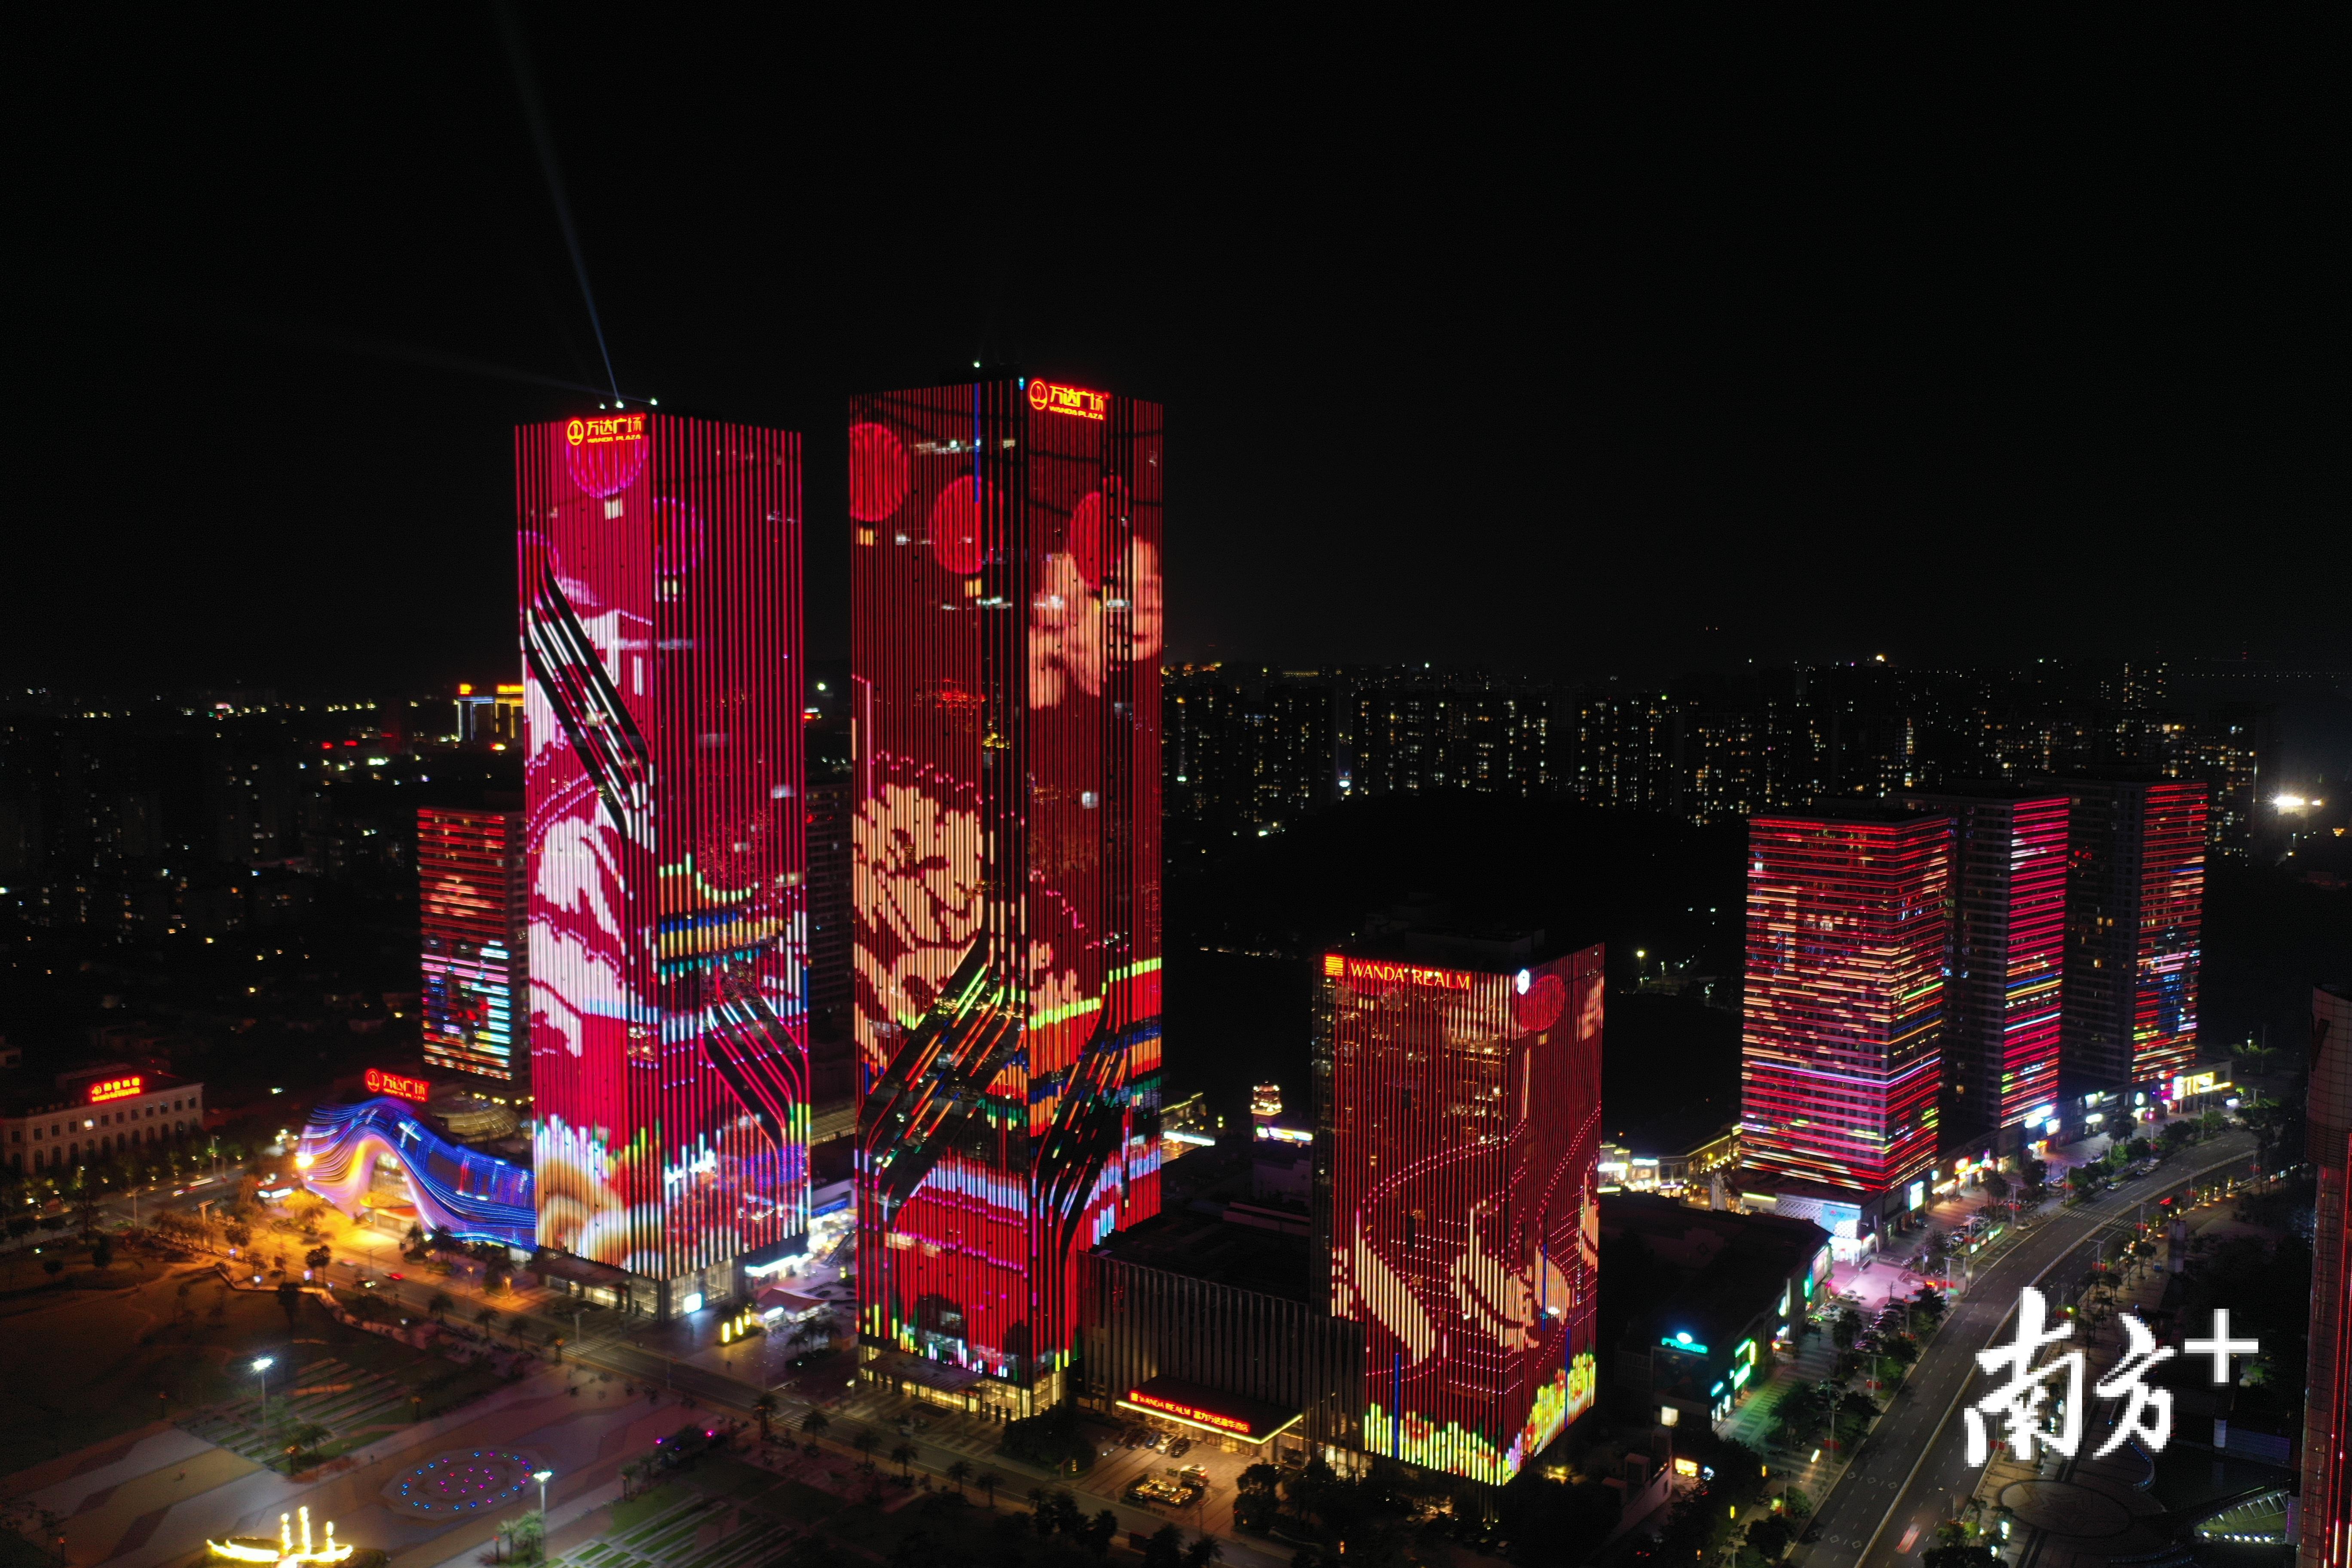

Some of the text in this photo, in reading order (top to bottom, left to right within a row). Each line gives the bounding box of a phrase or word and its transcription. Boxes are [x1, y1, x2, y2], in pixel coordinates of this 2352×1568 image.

[1049, 386, 1104, 412] 万达广场
[1049, 406, 1103, 420] WANDA PLAZA
[586, 416, 642, 436] 万达广场
[1351, 962, 1470, 990] WANDA REALM
[383, 1075, 426, 1095] 万达广场
[1165, 1403, 1191, 1415] REALM
